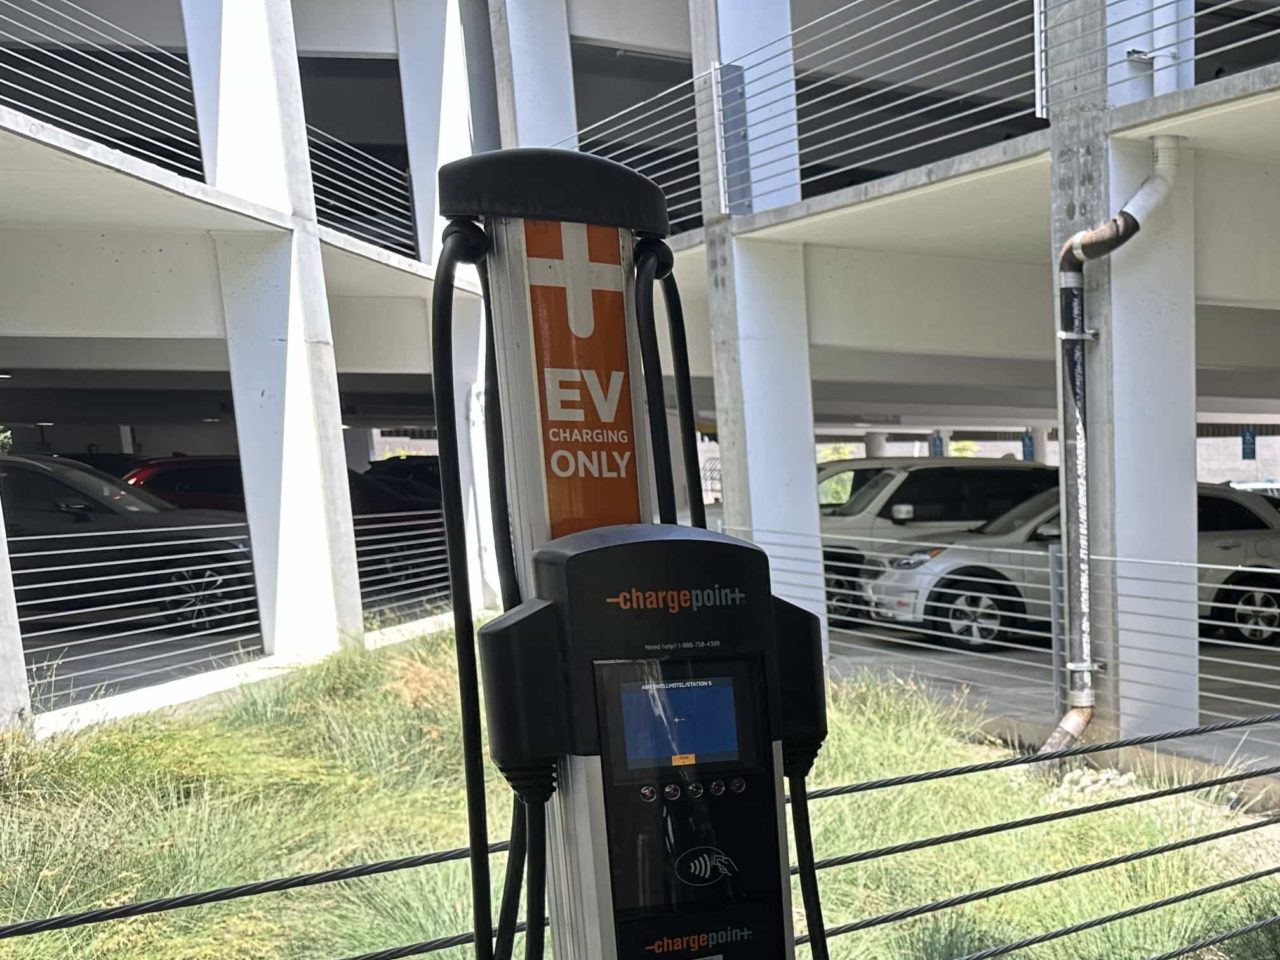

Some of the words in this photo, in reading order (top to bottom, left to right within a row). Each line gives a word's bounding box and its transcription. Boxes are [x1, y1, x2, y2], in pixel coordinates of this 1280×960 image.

[544, 367, 625, 423] EV
[548, 427, 629, 444] CHARGING
[550, 450, 632, 479] ONLY
